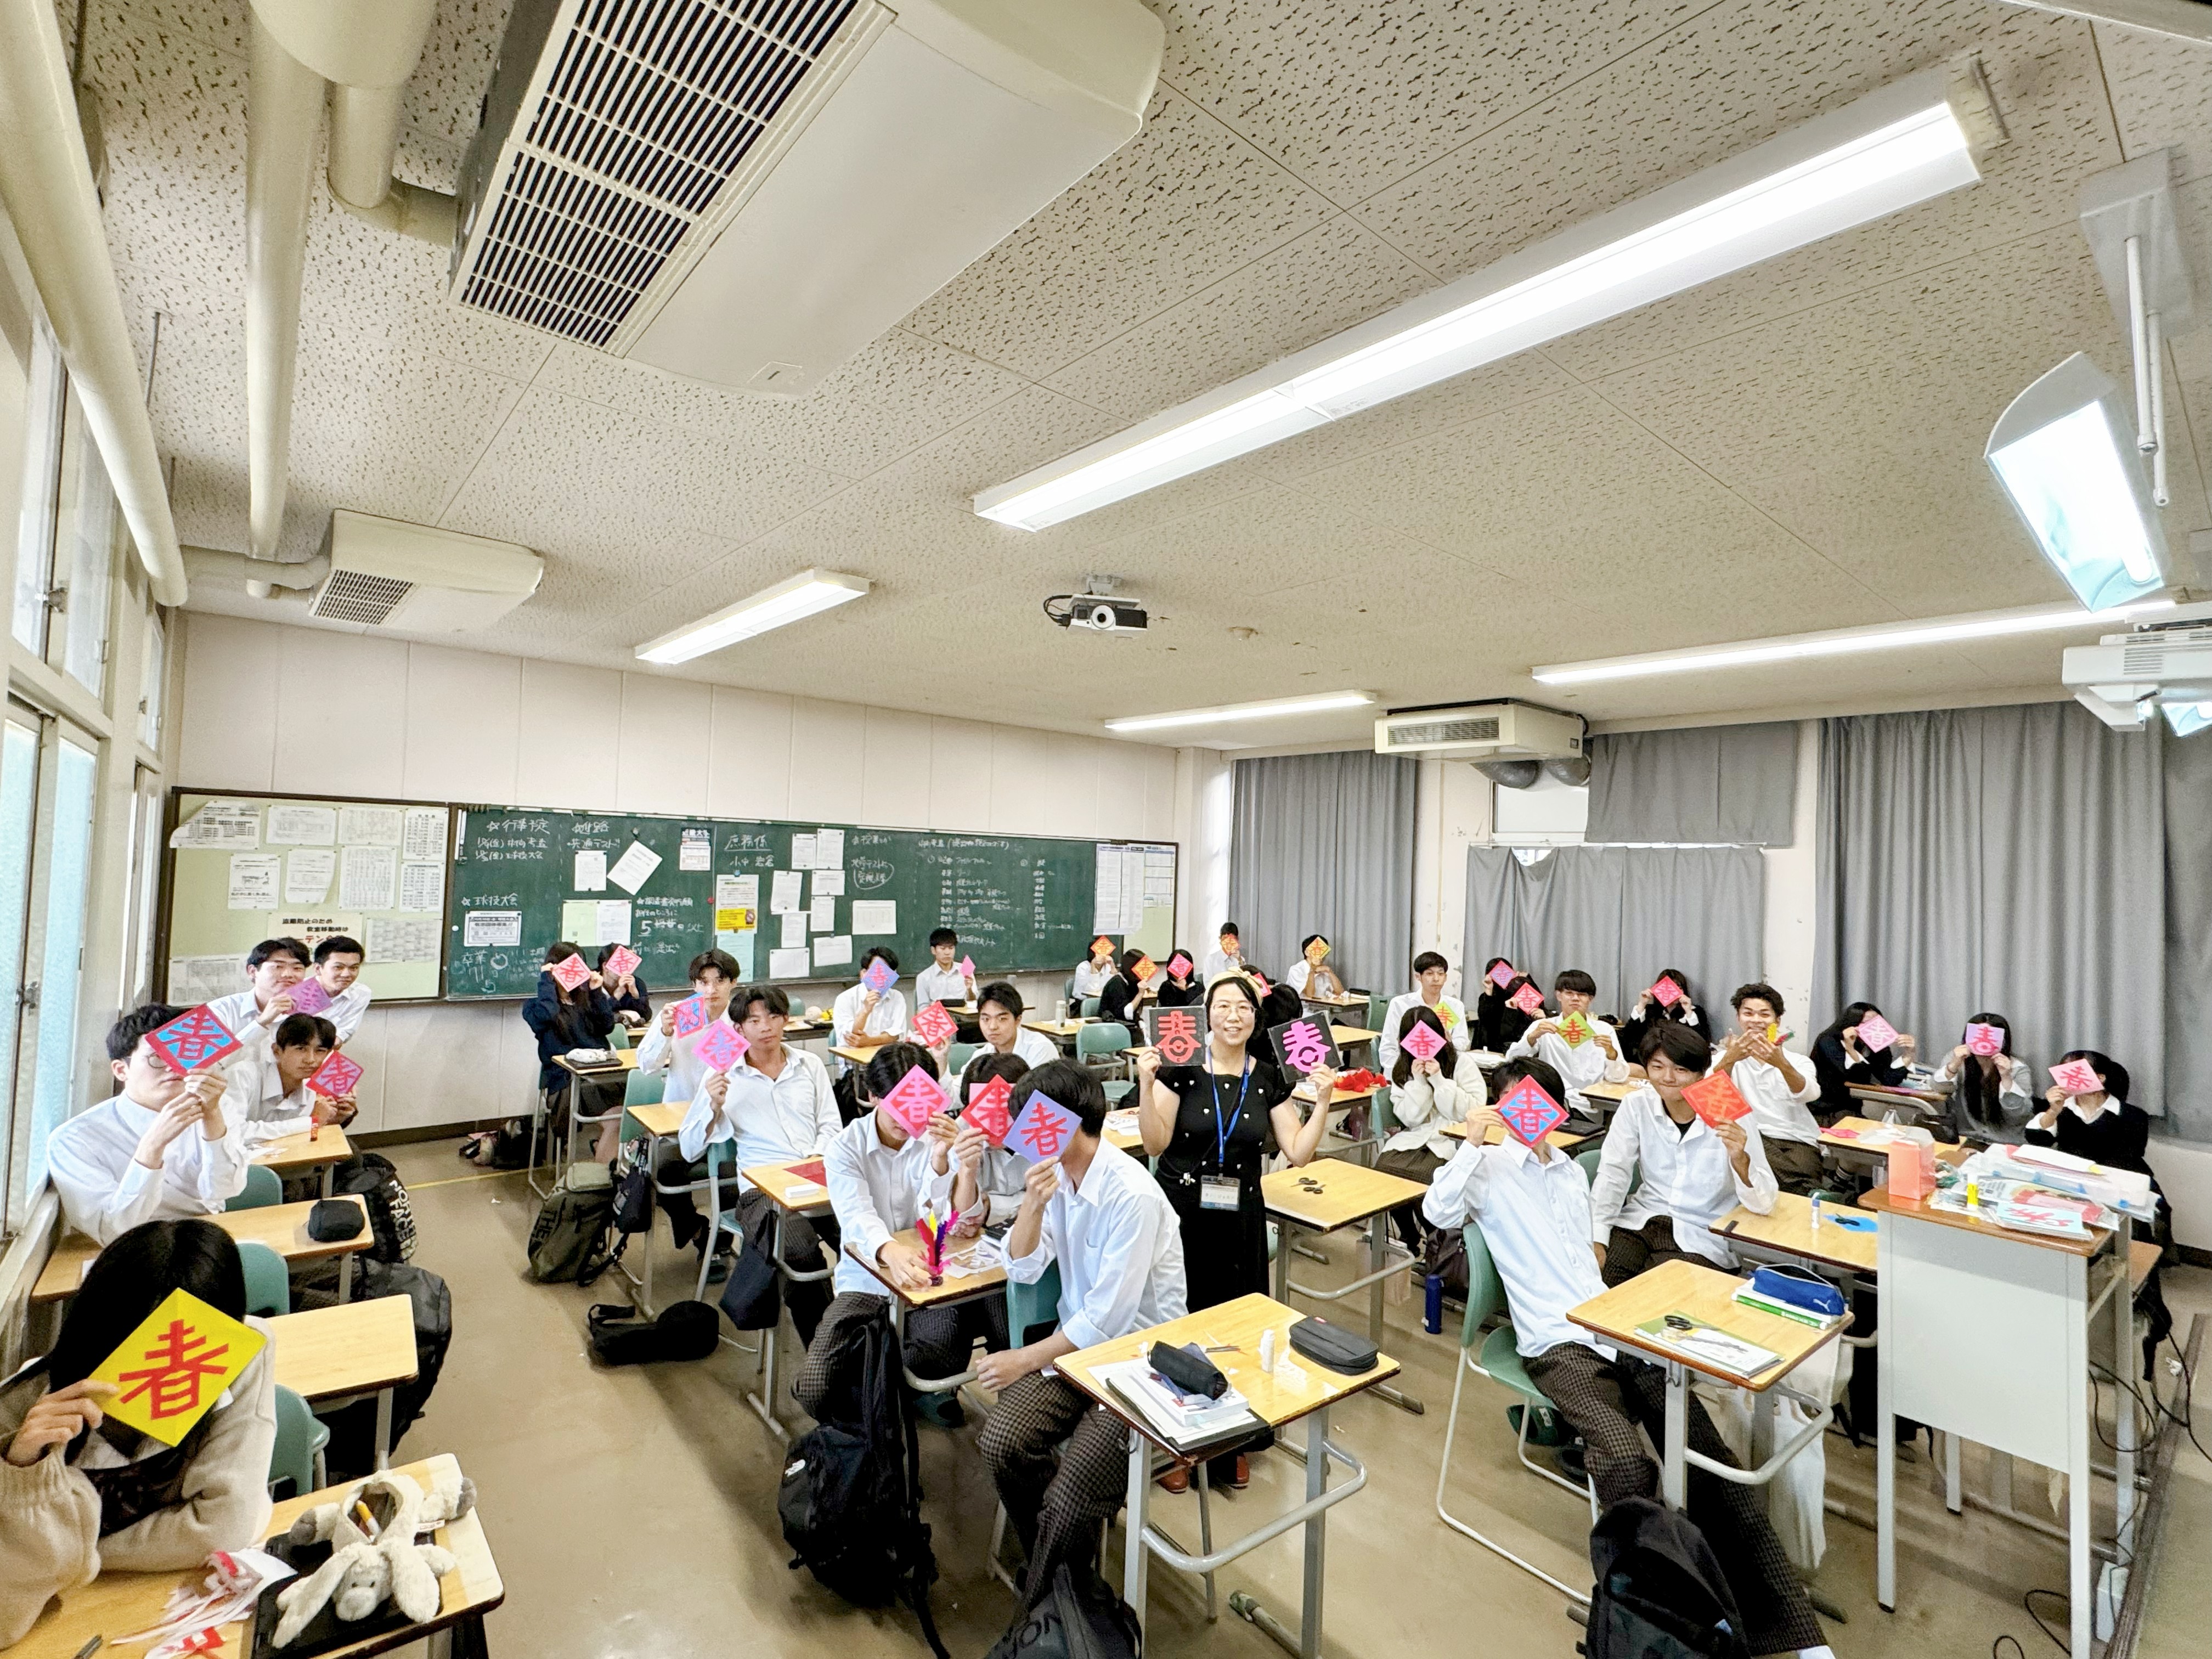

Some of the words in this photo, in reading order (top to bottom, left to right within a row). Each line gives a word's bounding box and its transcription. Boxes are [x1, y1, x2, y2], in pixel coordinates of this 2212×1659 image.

[613, 948, 634, 974] 春
[1310, 939, 1326, 956] 春
[560, 957, 585, 983] 春
[1135, 958, 1154, 977] 春
[1518, 988, 1537, 1008] 春
[165, 1012, 224, 1060] 春
[919, 1008, 949, 1036] 春
[1155, 1010, 1202, 1064] 春
[1561, 1019, 1587, 1043] 春
[705, 1029, 737, 1064] 春
[1282, 1020, 1331, 1074] 春
[1409, 1028, 1436, 1056] 春
[320, 1057, 358, 1091] 春
[2060, 1065, 2092, 1090] 春
[893, 1077, 941, 1124] 春
[1508, 1087, 1552, 1133] 春
[1020, 1102, 1068, 1156] 春
[389, 1199, 409, 1242] FACE
[119, 1319, 229, 1420] 春
